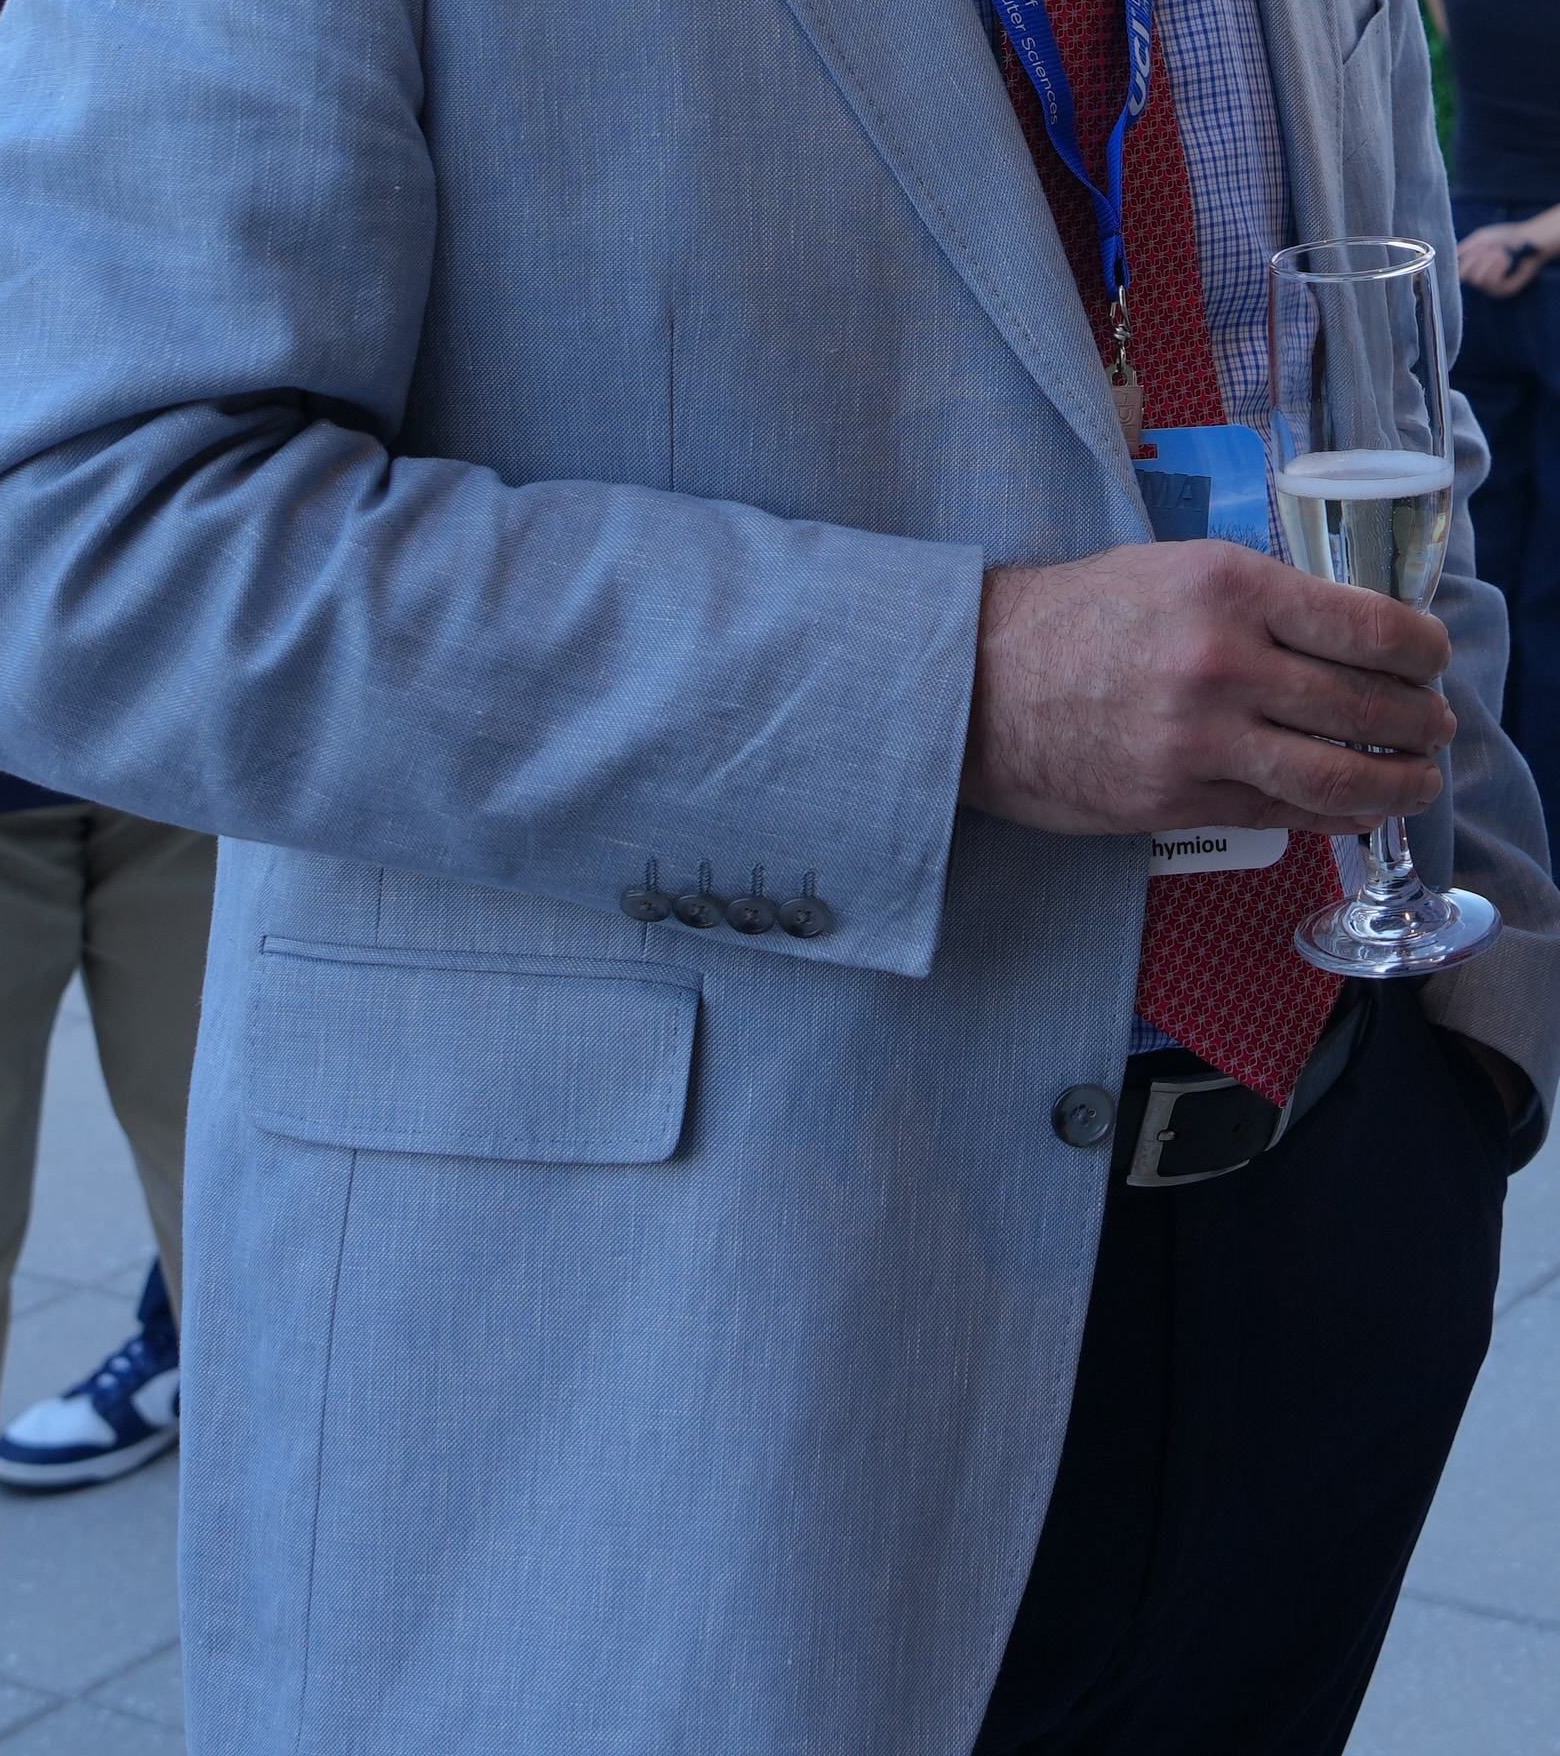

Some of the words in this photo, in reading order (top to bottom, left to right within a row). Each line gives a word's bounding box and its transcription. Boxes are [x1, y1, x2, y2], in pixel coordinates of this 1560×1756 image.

[1021, 37, 1058, 125] Sciences
[1129, 19, 1150, 116] UCI
[1152, 835, 1227, 860] hymiou
